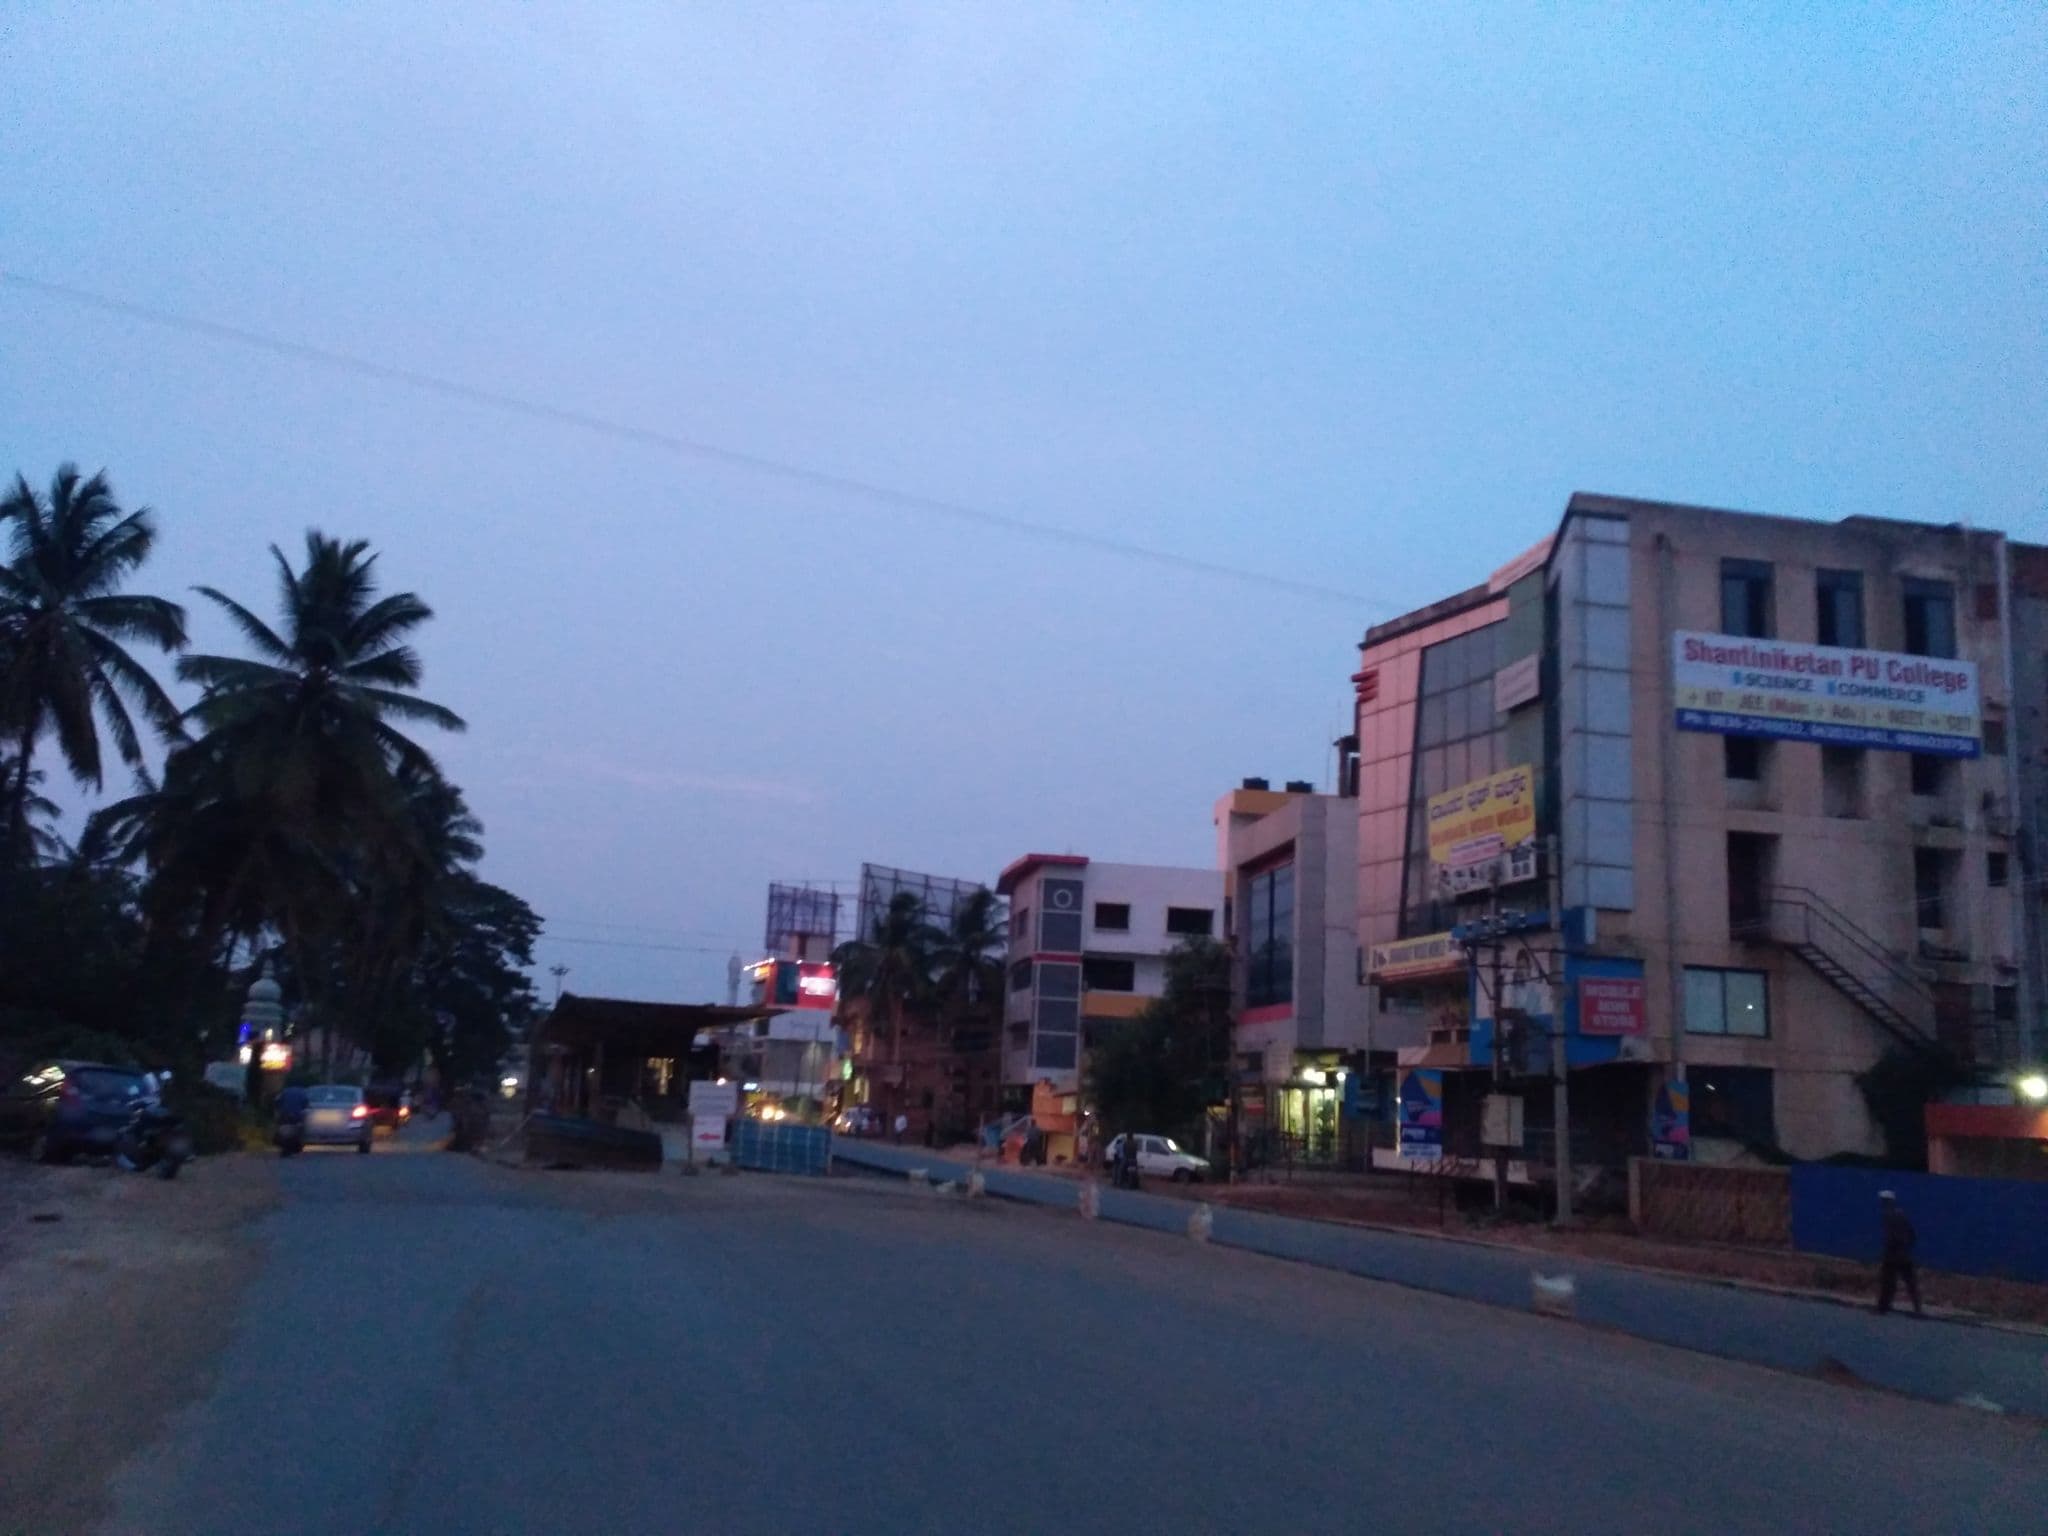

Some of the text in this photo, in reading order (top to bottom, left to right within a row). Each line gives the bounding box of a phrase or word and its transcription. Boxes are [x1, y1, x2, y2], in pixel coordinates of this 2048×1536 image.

[1685, 638, 1969, 693] Shantiniketan PU College
[1745, 672, 1926, 703] SCIENCE COMMERCE
[1584, 984, 1641, 998] MOBILE
